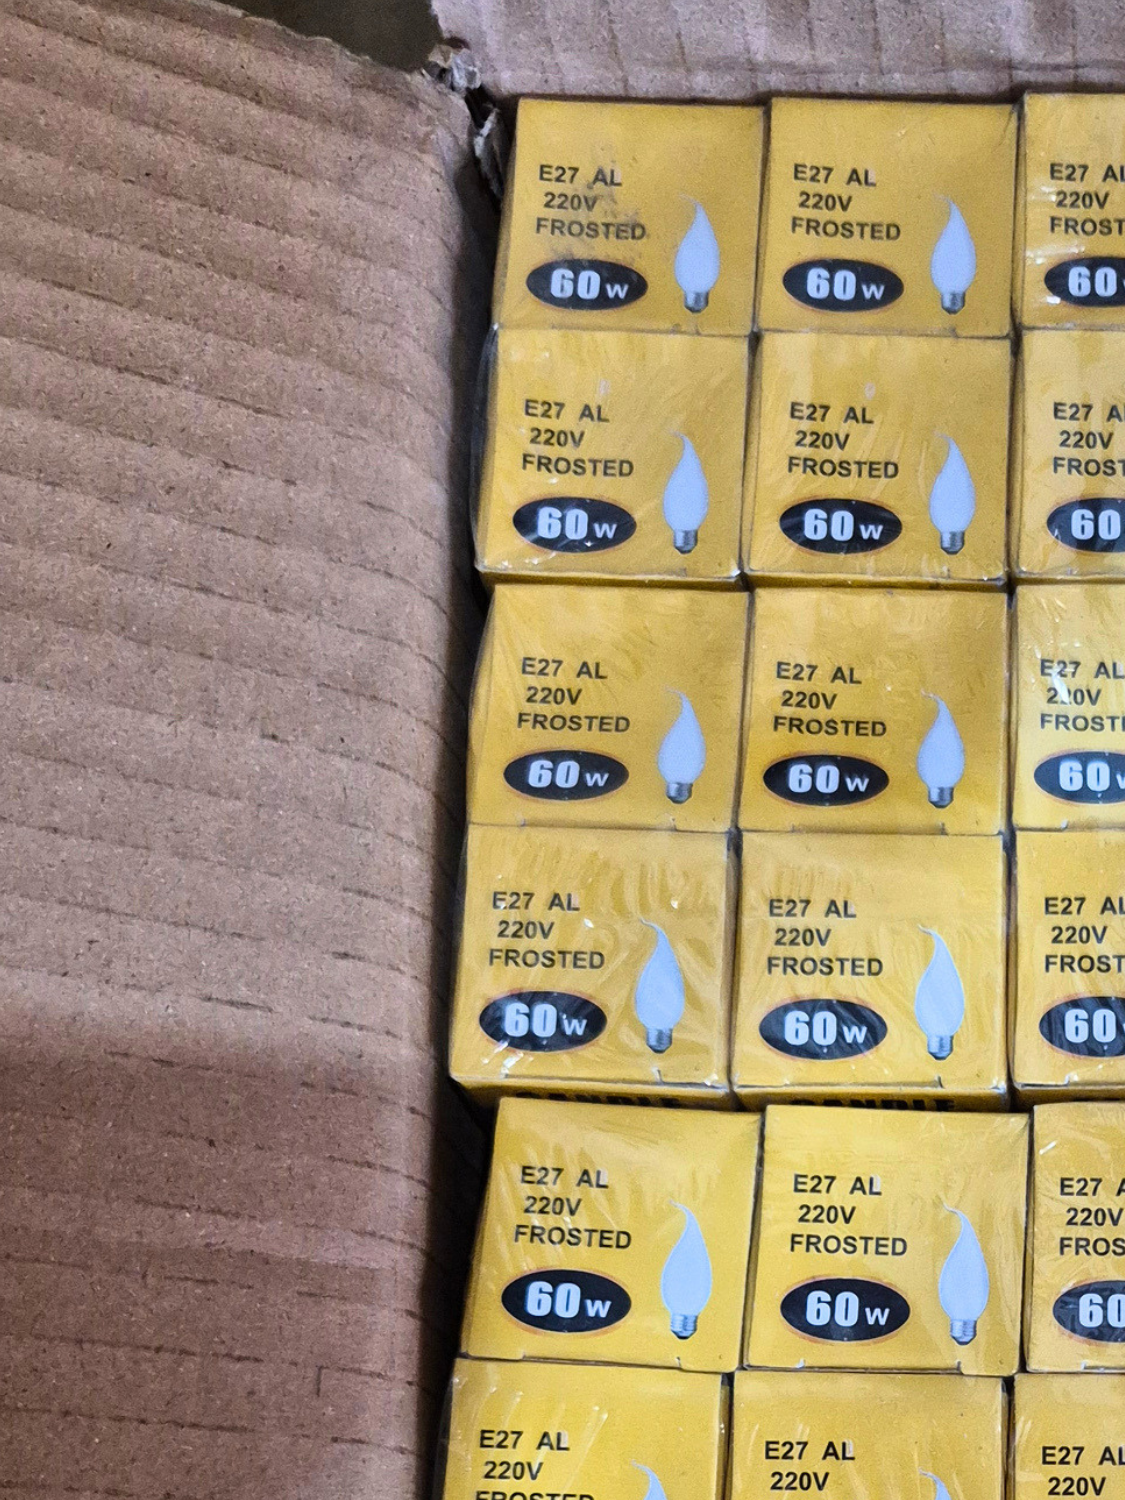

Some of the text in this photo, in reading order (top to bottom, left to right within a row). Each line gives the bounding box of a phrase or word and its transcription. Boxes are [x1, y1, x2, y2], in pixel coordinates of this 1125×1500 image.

[539, 164, 621, 186] E27 AL
[1050, 163, 1088, 182] E27
[544, 192, 597, 210] 220V
[1057, 191, 1109, 209] 220V
[537, 218, 646, 239] FROSTED
[790, 402, 873, 424] E27 AL
[1054, 402, 1093, 421] E27
[795, 430, 849, 450] 220V
[1060, 430, 1113, 449] 220V
[788, 456, 898, 478] FROSTED
[522, 657, 606, 679] E27 AL
[777, 661, 861, 684] E27 AL
[526, 686, 582, 705] 220V
[782, 690, 837, 709] 220V
[518, 712, 629, 732] FROSTED
[773, 716, 886, 736] FROSTED
[493, 891, 579, 911] E27 AL
[769, 899, 856, 918] E27 AL
[498, 920, 554, 939] 220V
[775, 928, 831, 946] 220V
[489, 949, 604, 969] FROSTED
[767, 957, 883, 976] FROSTED
[521, 1165, 608, 1189] E27 AL
[1060, 1177, 1102, 1196] E27
[523, 1196, 581, 1216] 220V
[1066, 1207, 1123, 1226] 220V
[515, 1224, 631, 1249] FROSTED
[765, 1441, 855, 1461] E27 AL
[770, 1471, 829, 1491] 220V
